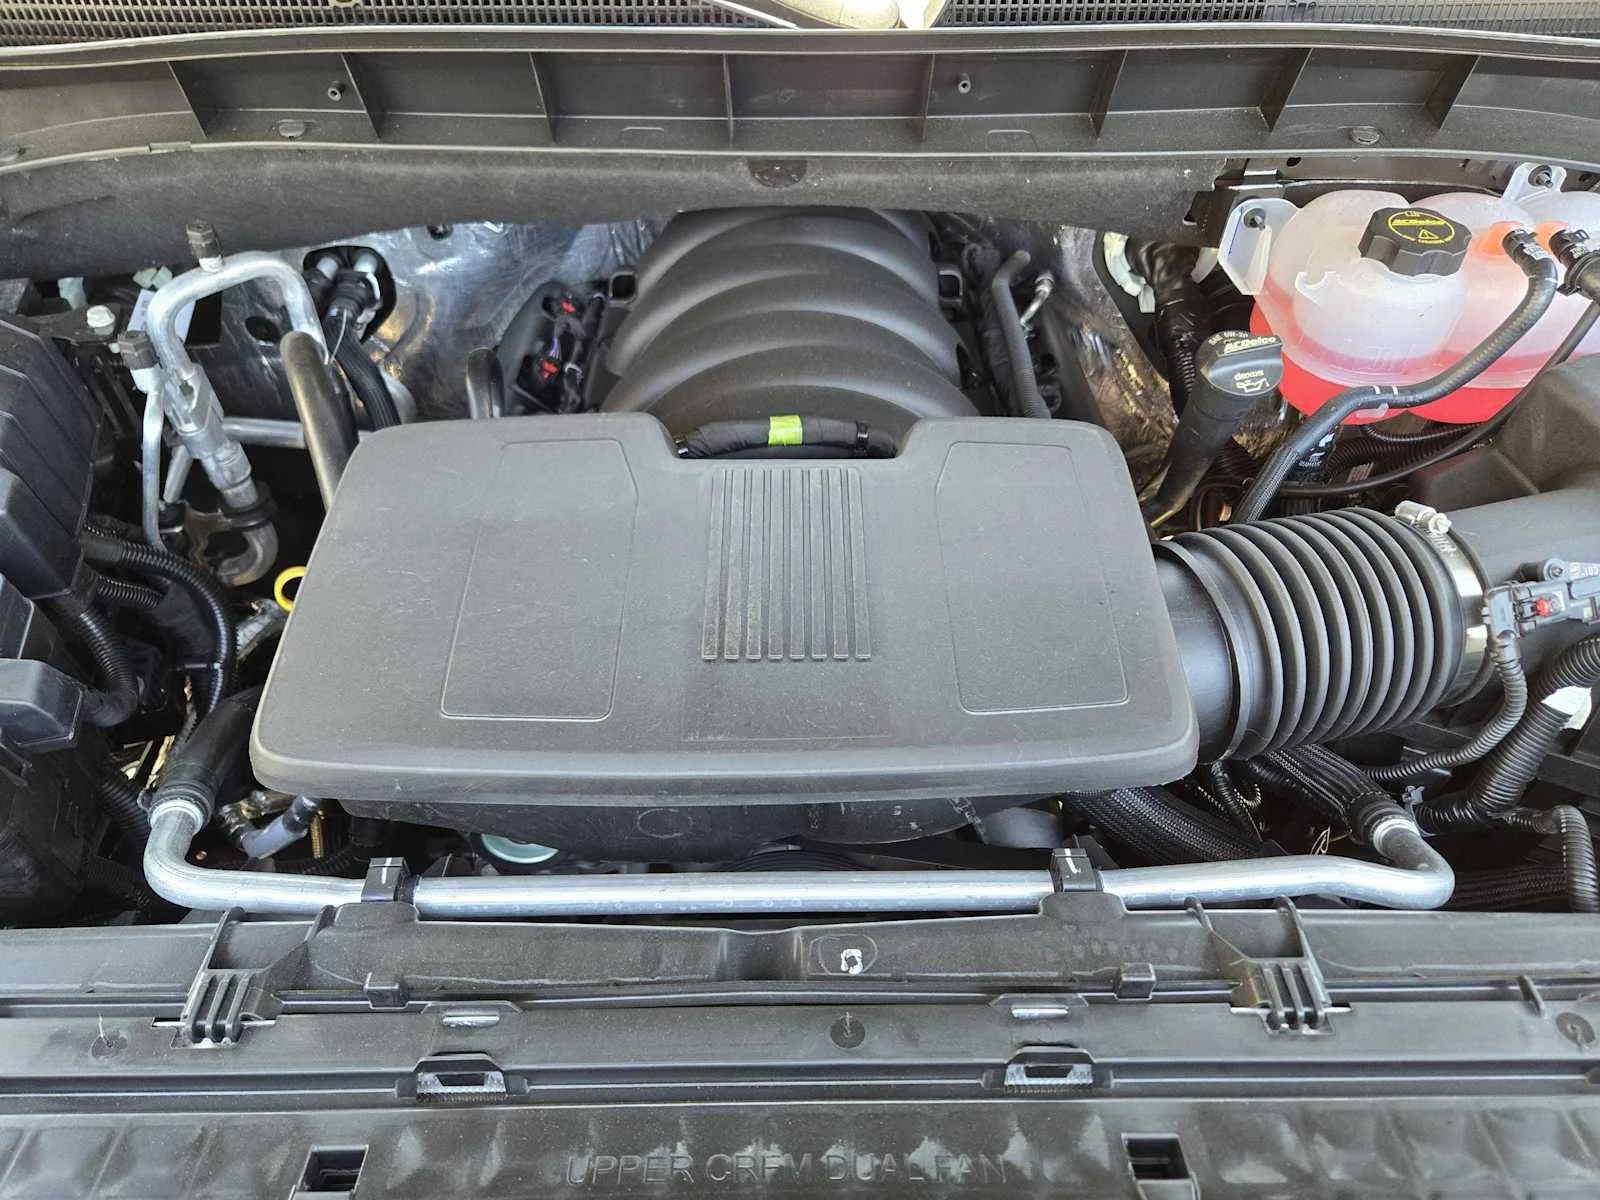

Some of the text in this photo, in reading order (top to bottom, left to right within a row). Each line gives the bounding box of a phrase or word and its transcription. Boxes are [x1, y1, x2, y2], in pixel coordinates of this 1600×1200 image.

[1224, 335, 1278, 356] ACDelco
[1234, 369, 1265, 381] dexos
[566, 1153, 696, 1186] UPPER
[825, 1152, 927, 1184] DUAL
[934, 1152, 1007, 1184] FAN
